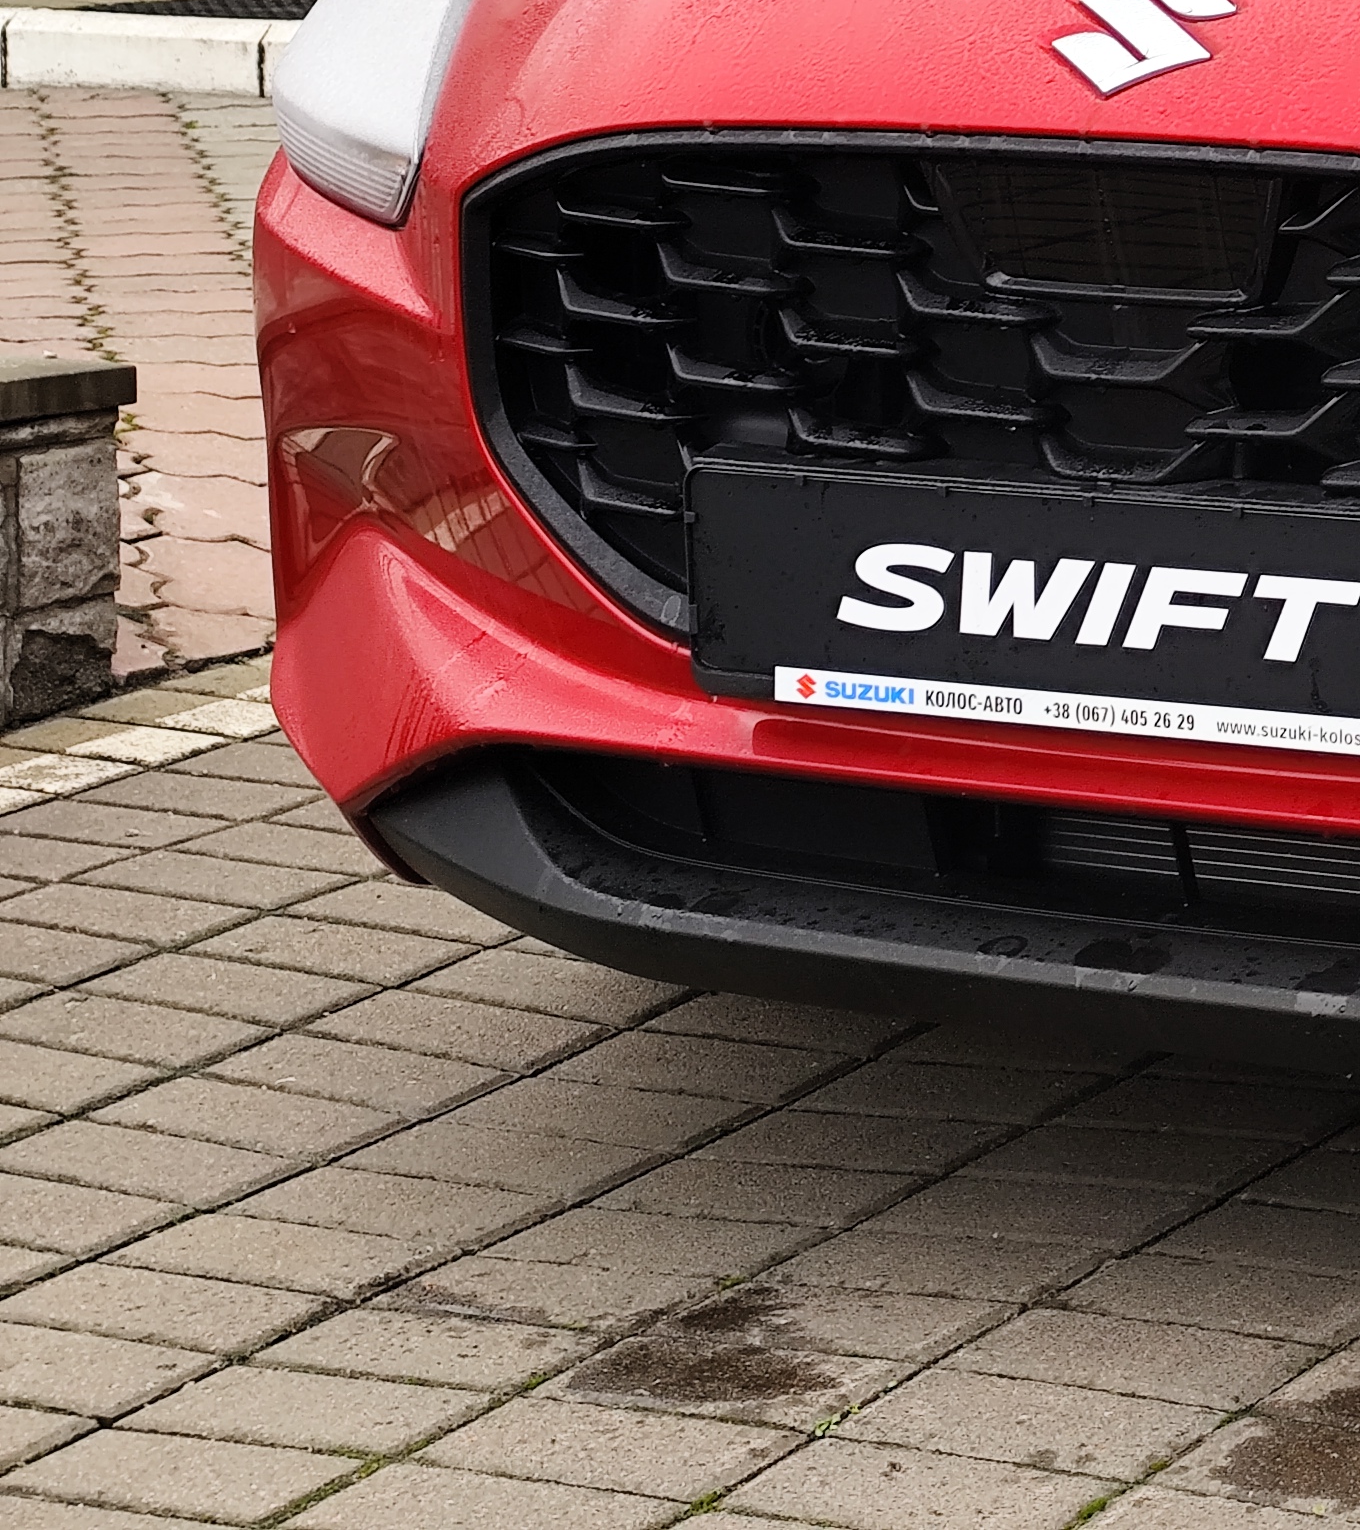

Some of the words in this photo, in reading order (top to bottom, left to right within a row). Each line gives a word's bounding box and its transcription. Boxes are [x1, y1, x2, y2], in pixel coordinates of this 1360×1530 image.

[825, 680, 914, 705] SUZUKI
[925, 689, 1023, 715] КОЛОС-АВТО
[1043, 702, 1070, 720] +38
[1075, 702, 1115, 727] (067)
[1121, 708, 1148, 727] 405
[1154, 712, 1171, 730] 26
[1177, 713, 1195, 732] 29
